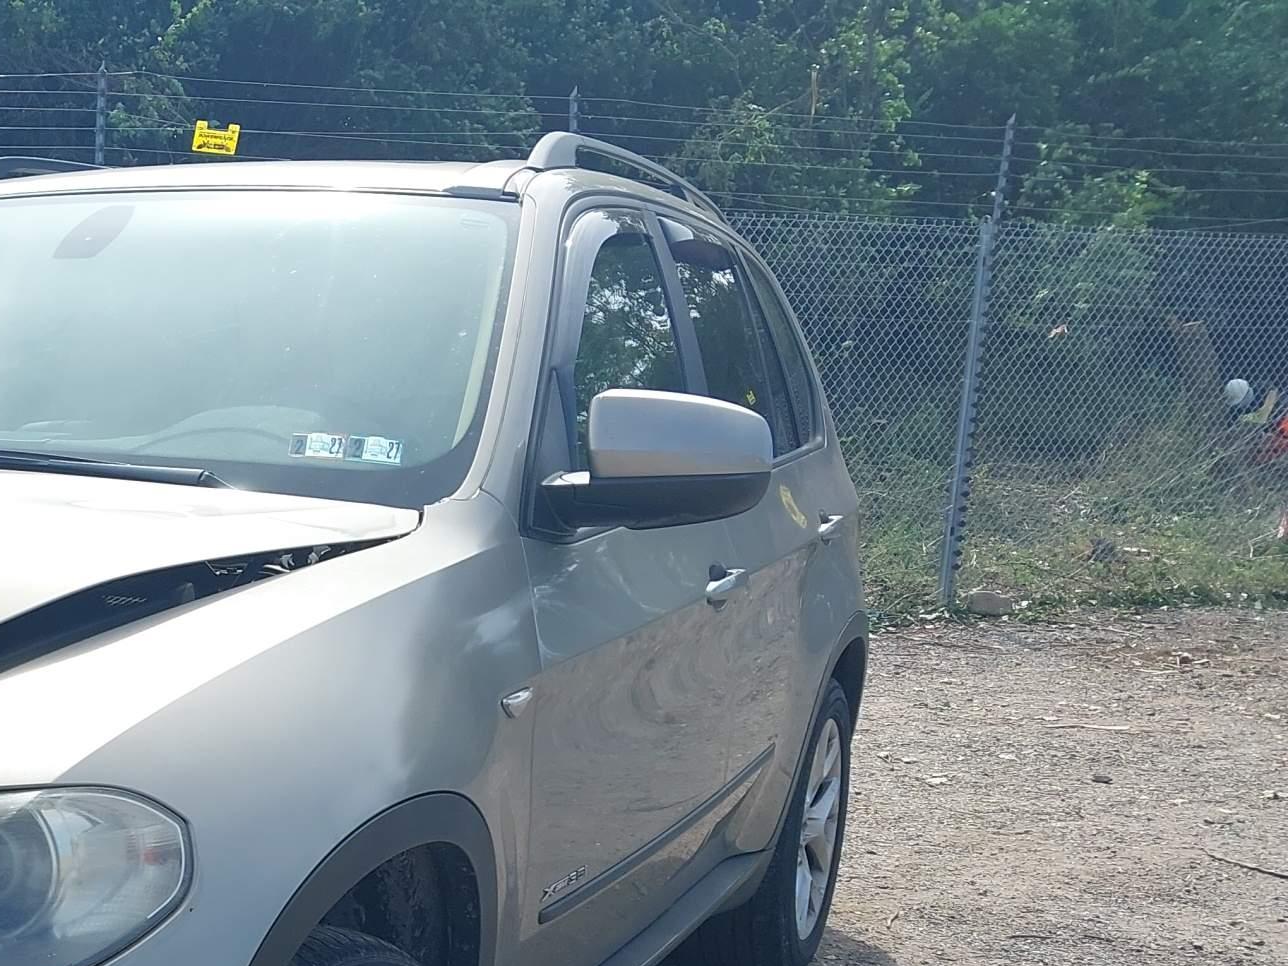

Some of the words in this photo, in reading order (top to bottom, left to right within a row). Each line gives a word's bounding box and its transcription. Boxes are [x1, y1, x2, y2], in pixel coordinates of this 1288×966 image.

[295, 439, 304, 455] 2
[329, 437, 343, 455] 27
[353, 439, 362, 458] 2
[386, 441, 401, 460] 27
